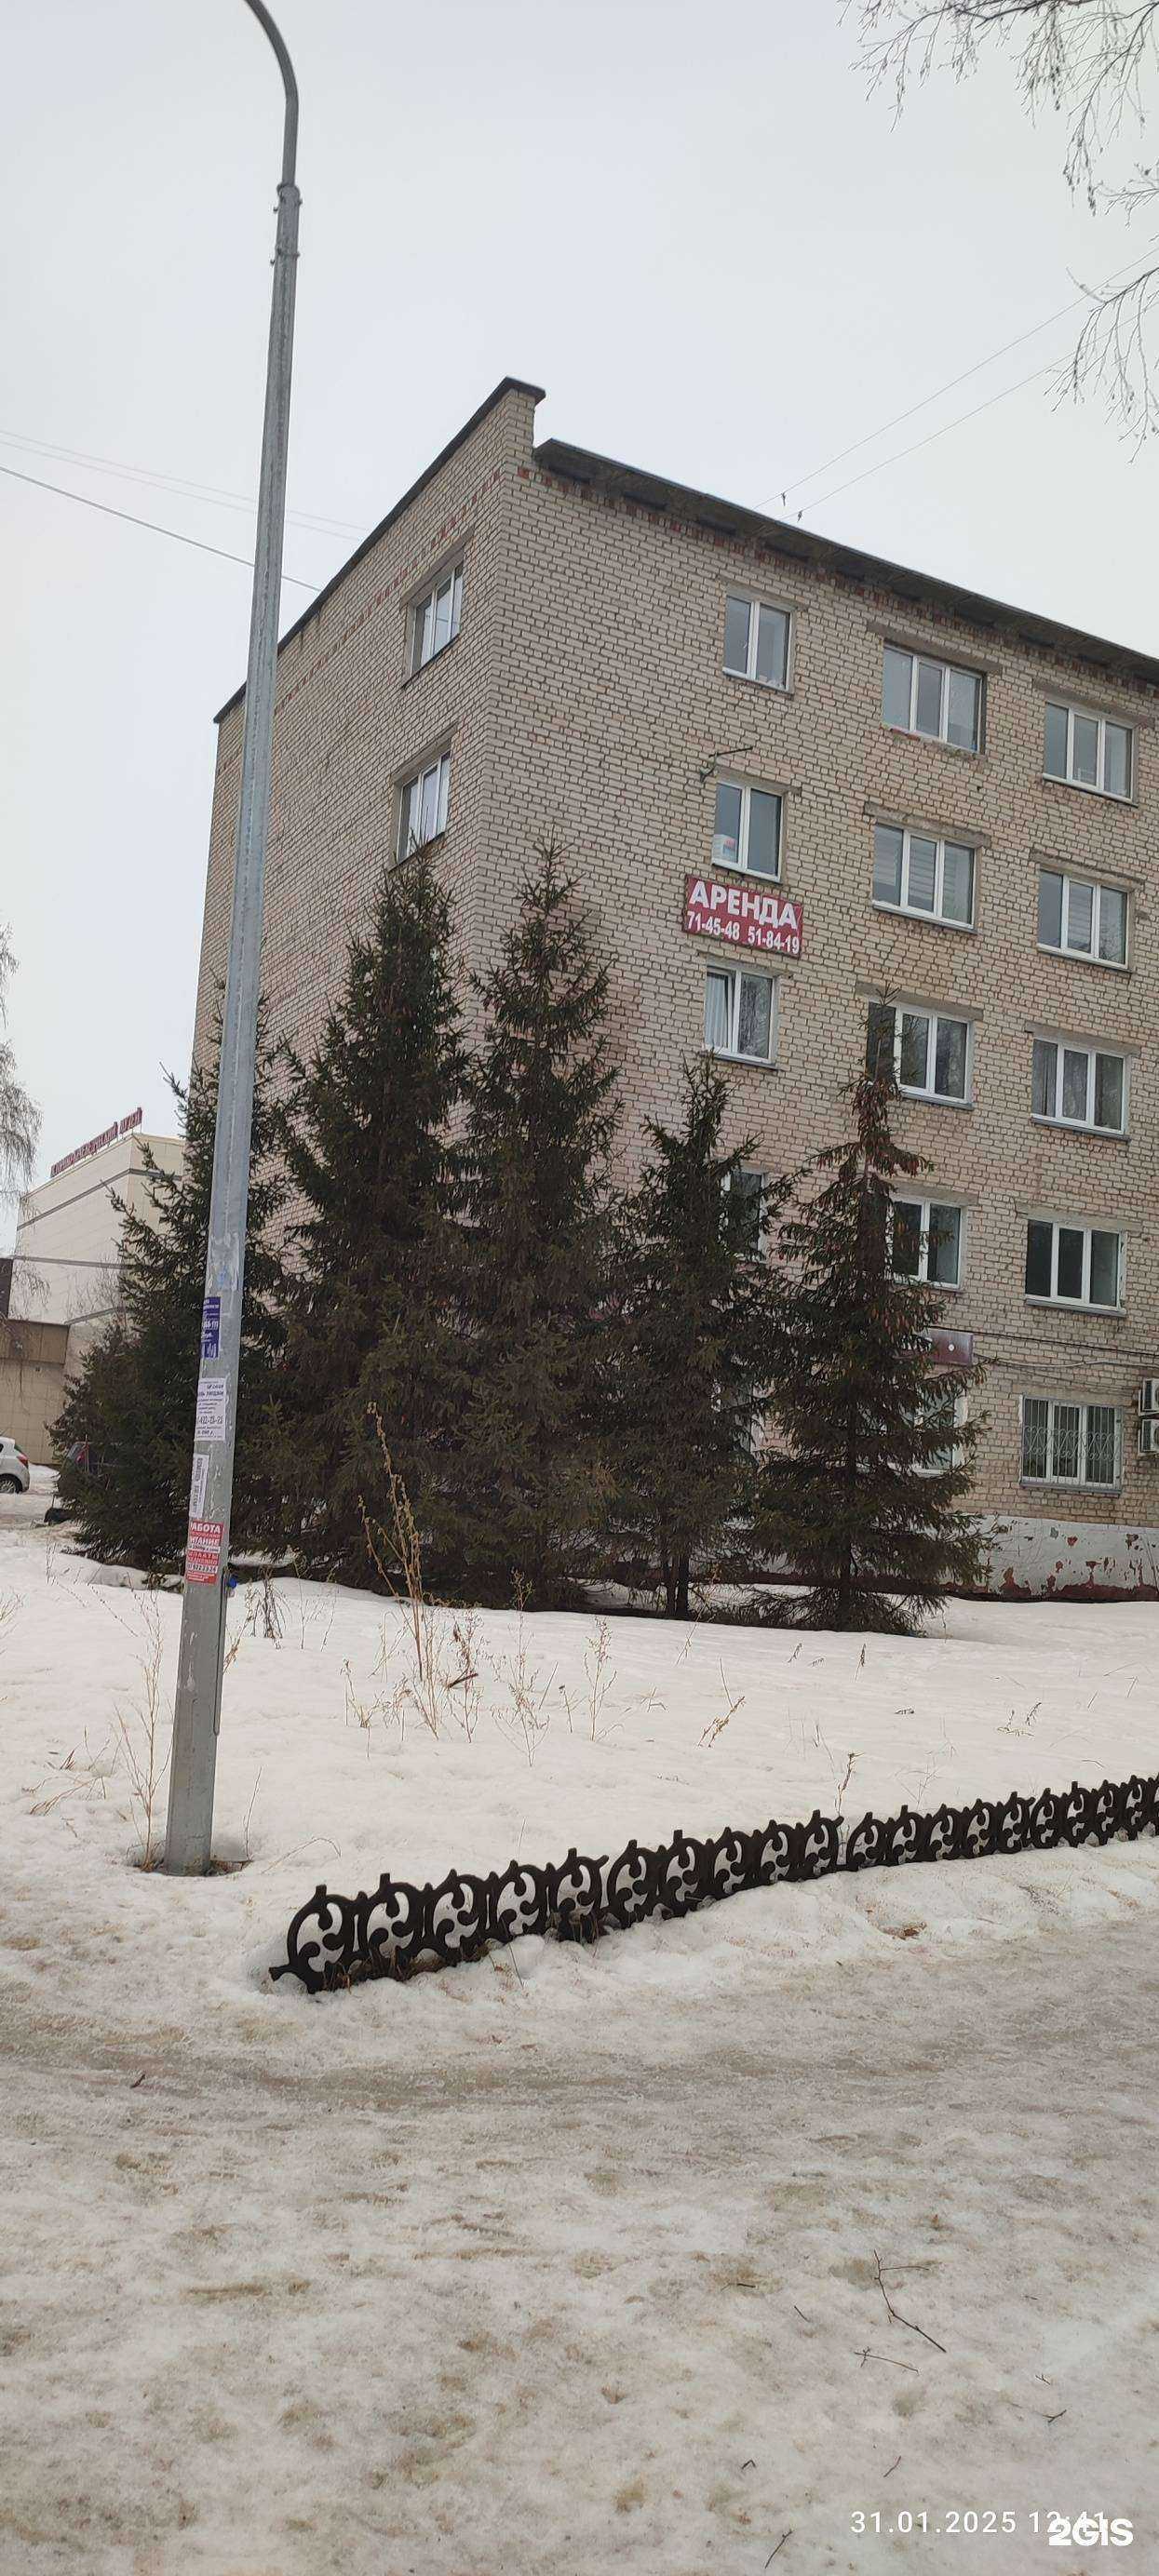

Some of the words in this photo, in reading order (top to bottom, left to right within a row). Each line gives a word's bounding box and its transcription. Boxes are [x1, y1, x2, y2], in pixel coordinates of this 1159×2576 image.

[689, 880, 798, 930] АРЕНДА
[688, 910, 740, 941] 71-45-48
[748, 927, 800, 955] 51-84-19
